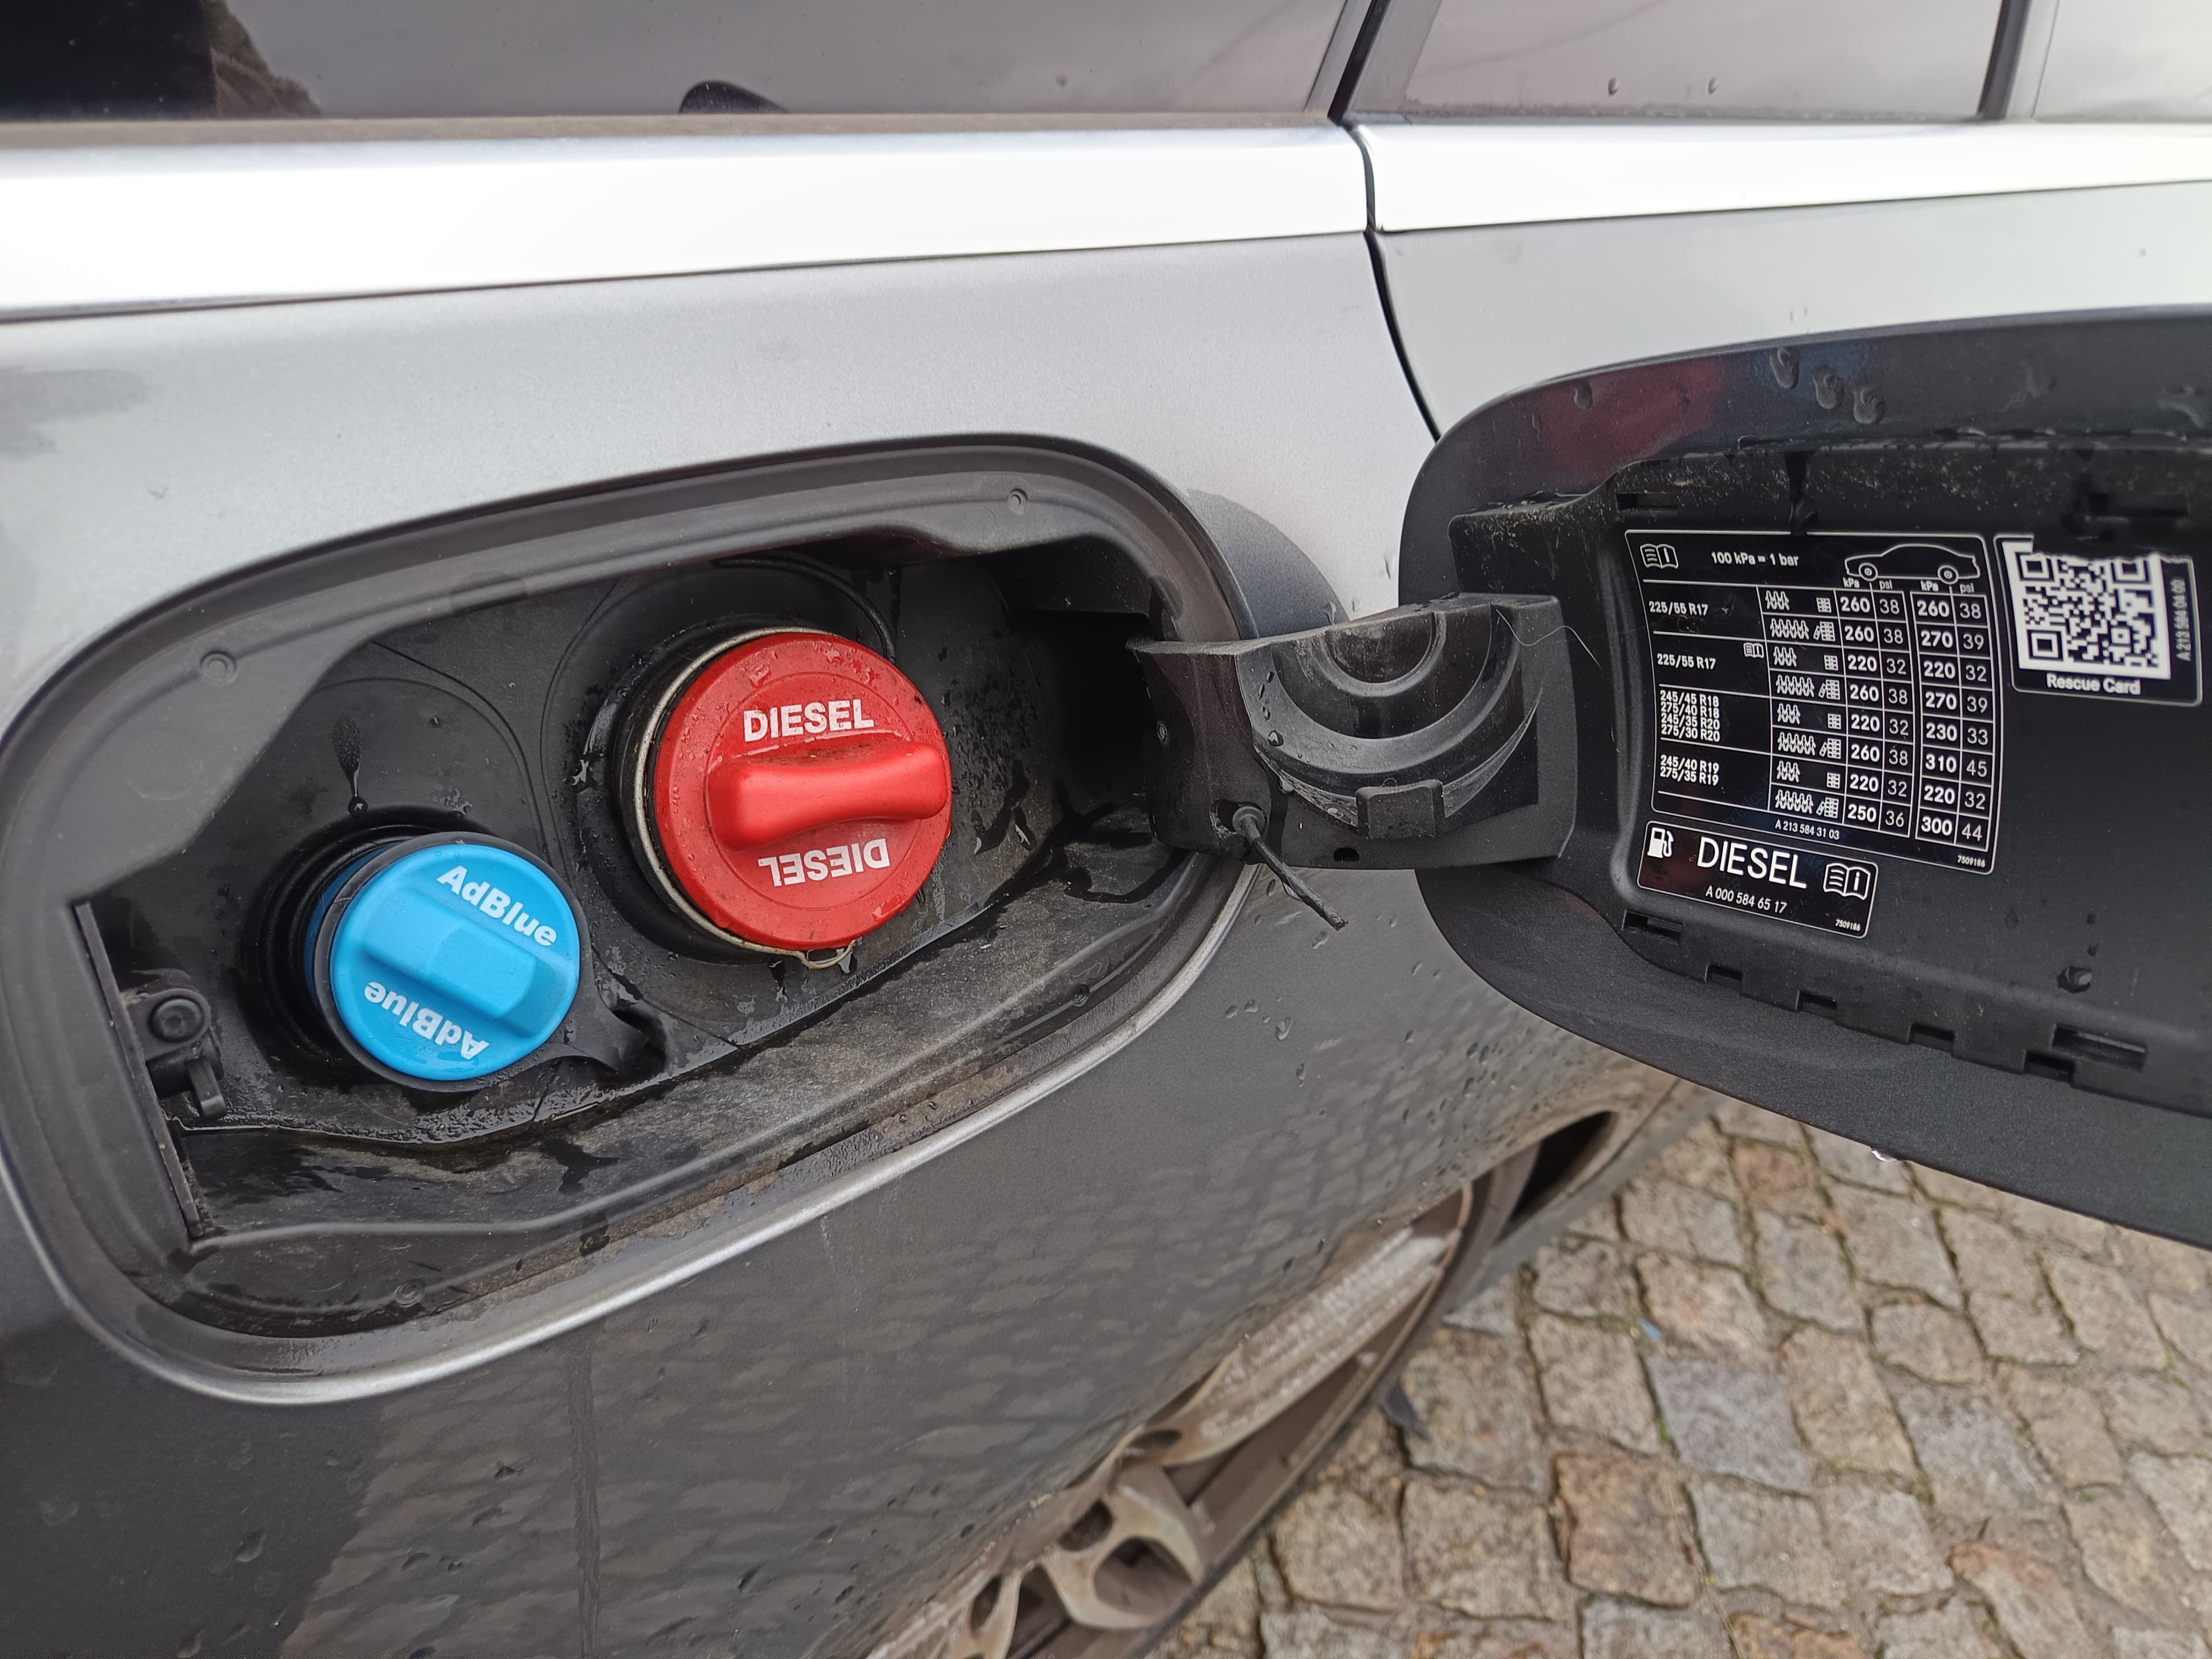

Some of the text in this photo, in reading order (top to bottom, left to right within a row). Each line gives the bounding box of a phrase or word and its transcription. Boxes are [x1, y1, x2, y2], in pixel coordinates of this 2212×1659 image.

[1711, 552, 1732, 565] 100
[1733, 552, 1756, 565] kPa
[1770, 554, 1776, 565] 1
[1779, 553, 1799, 566] bar
[1843, 578, 1975, 593] kPa psi kPa psi
[1649, 601, 1709, 616] 225/55 R17
[1840, 597, 1982, 619] 260 38 260 38
[1844, 626, 1984, 650] 260 38 270 39
[2175, 631, 2191, 651] 213
[1657, 653, 1716, 670] 225/55 R17
[2176, 652, 2191, 661] A
[1848, 655, 1987, 682] 220 32 220 32
[2047, 673, 2141, 695] Rescue Card
[1660, 690, 1719, 707] 245/45 R18
[1661, 701, 1719, 718] 275/40 R18
[1850, 684, 1988, 713] 260 38 270 39
[744, 699, 874, 743] DIESEL
[1661, 712, 1720, 730] 245/35 R20
[1851, 714, 1988, 745] 220 32 230 33
[1661, 724, 1720, 742] 275/30 R20
[1660, 755, 1719, 774] 245/40 R19
[1851, 744, 1987, 777] 260 38 310 45
[1660, 766, 1719, 786] 275/35 R19
[1850, 774, 1986, 810] 220 32 220 32
[1775, 819, 1840, 840] A 213 584 31 03
[1847, 804, 1982, 842] 250 36 300 44
[759, 838, 891, 887] DIESEL
[1697, 836, 1807, 889] DIESEL
[1957, 855, 1986, 868] 7509186
[437, 865, 557, 946] AdBlue
[1705, 885, 1787, 914] A 000 584 65 17
[364, 982, 490, 1060] AdBlue
